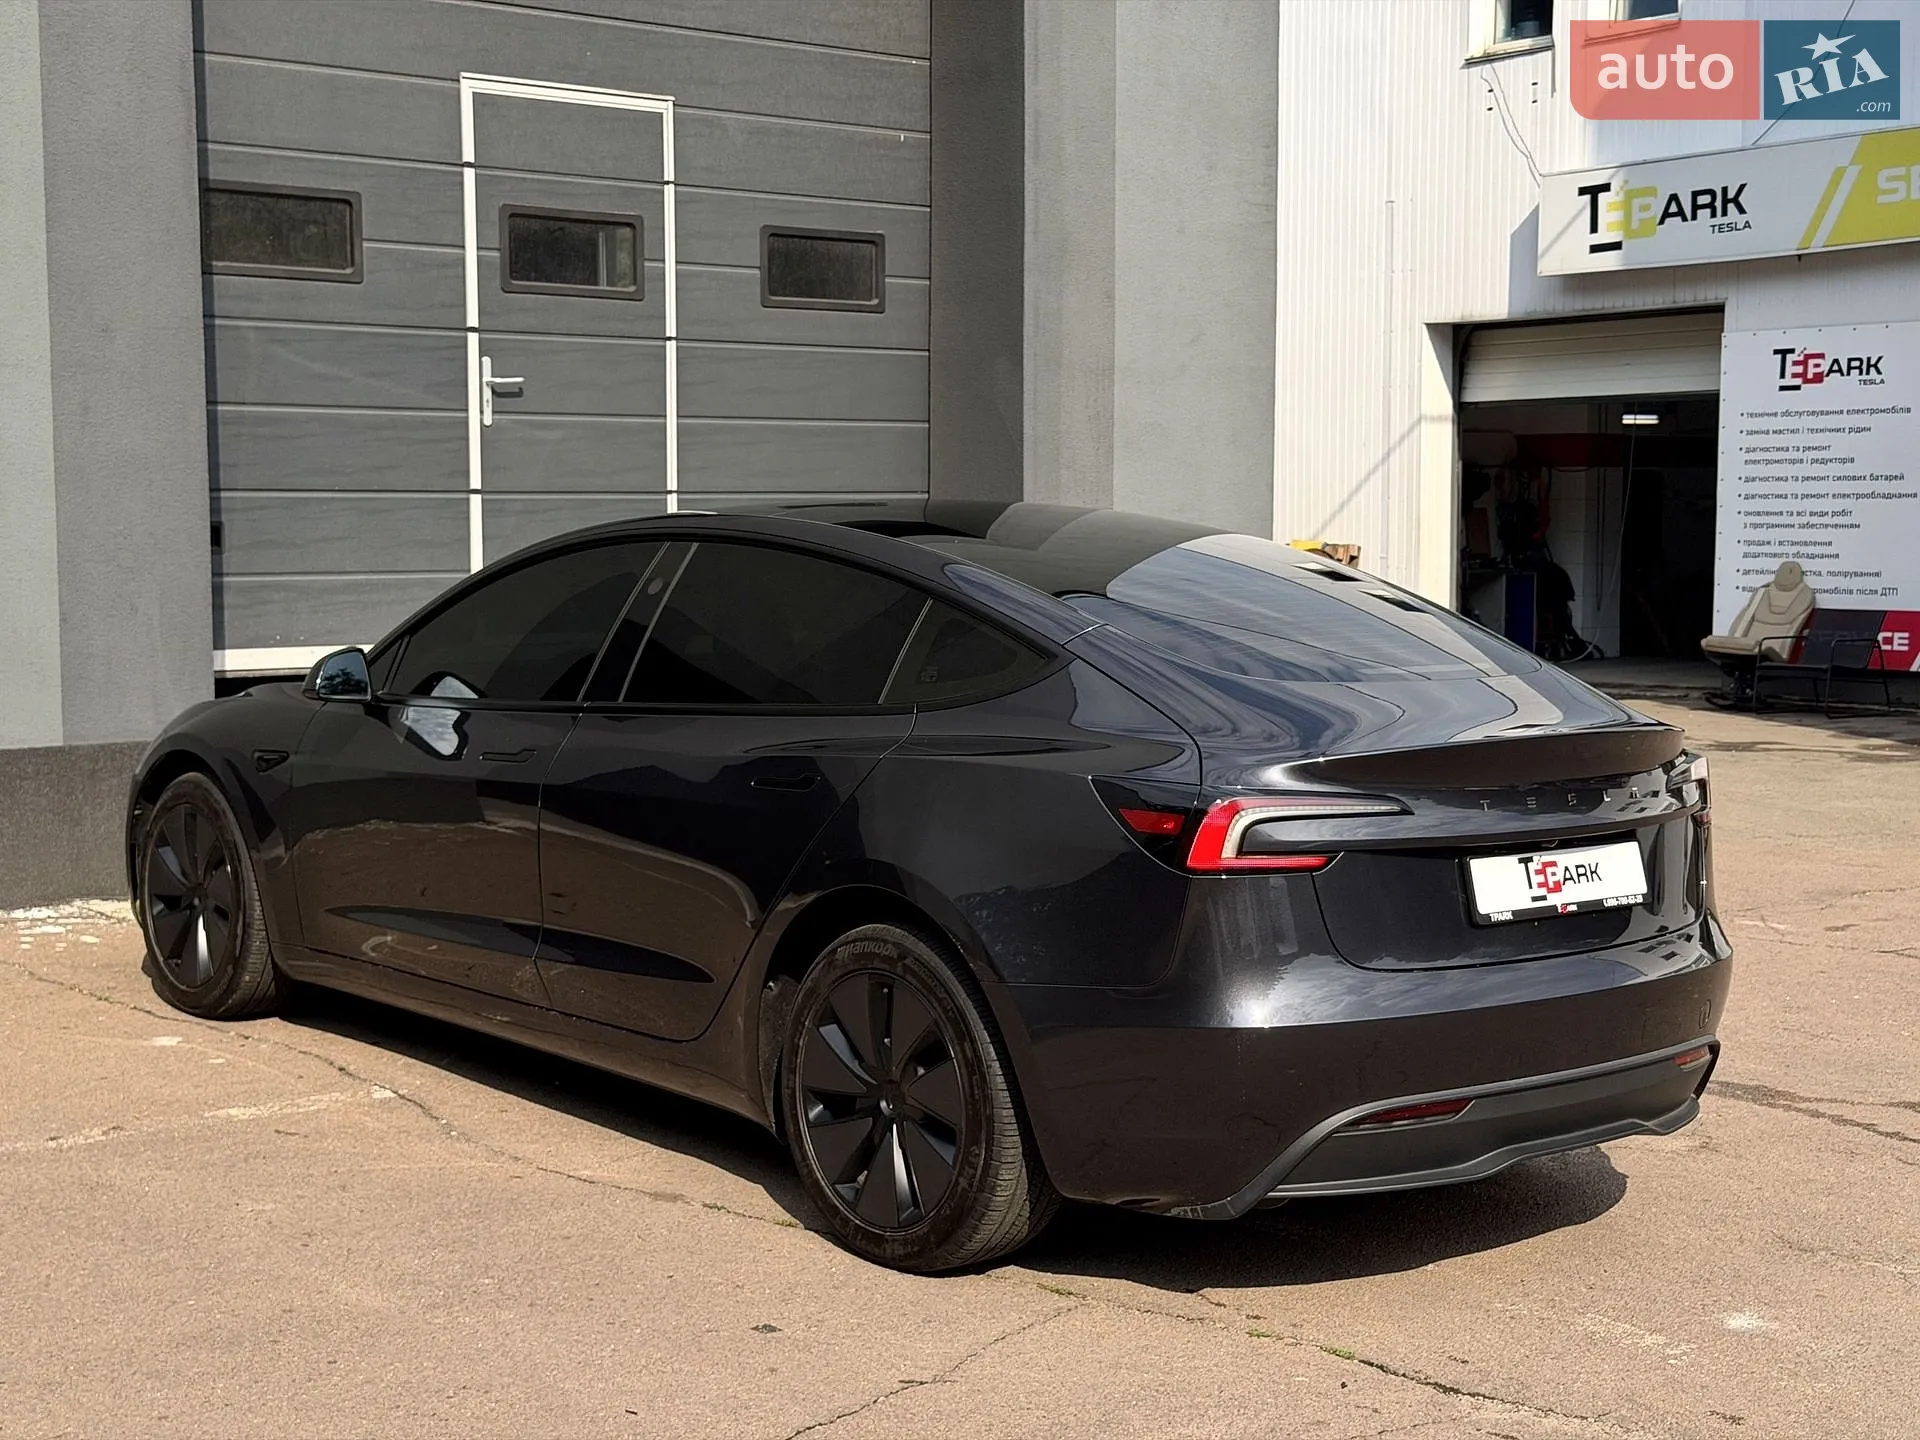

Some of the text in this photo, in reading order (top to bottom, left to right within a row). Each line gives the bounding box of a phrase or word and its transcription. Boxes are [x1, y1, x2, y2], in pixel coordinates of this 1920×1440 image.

[1709, 220, 1752, 235] TESLA
[1746, 405, 1911, 419] технічне обслуговування електромобілів
[1772, 427, 1799, 435] мастил
[1848, 425, 1871, 434] рідин
[1745, 446, 1789, 454] діагностика
[1802, 445, 1832, 453] ремонт
[1744, 457, 1804, 465] електромоторів
[1811, 456, 1854, 465] редукторів
[1744, 475, 1788, 483] діагностика
[1870, 473, 1904, 482] батарей
[1744, 492, 1788, 500] діагностика
[1801, 492, 1829, 500] ремонт
[1832, 491, 1917, 500] електрообладнання
[1831, 510, 1853, 518] робіт
[1750, 522, 1795, 530] програмним
[1743, 539, 1772, 547] продаж
[1742, 551, 1839, 560] додаткового обладнання
[1742, 568, 1778, 576] детейлін
[1856, 587, 1878, 595] після
[1881, 588, 1898, 596] ДТП
[1480, 788, 1639, 812] TESLA
[1490, 911, 1514, 922] TPARK
